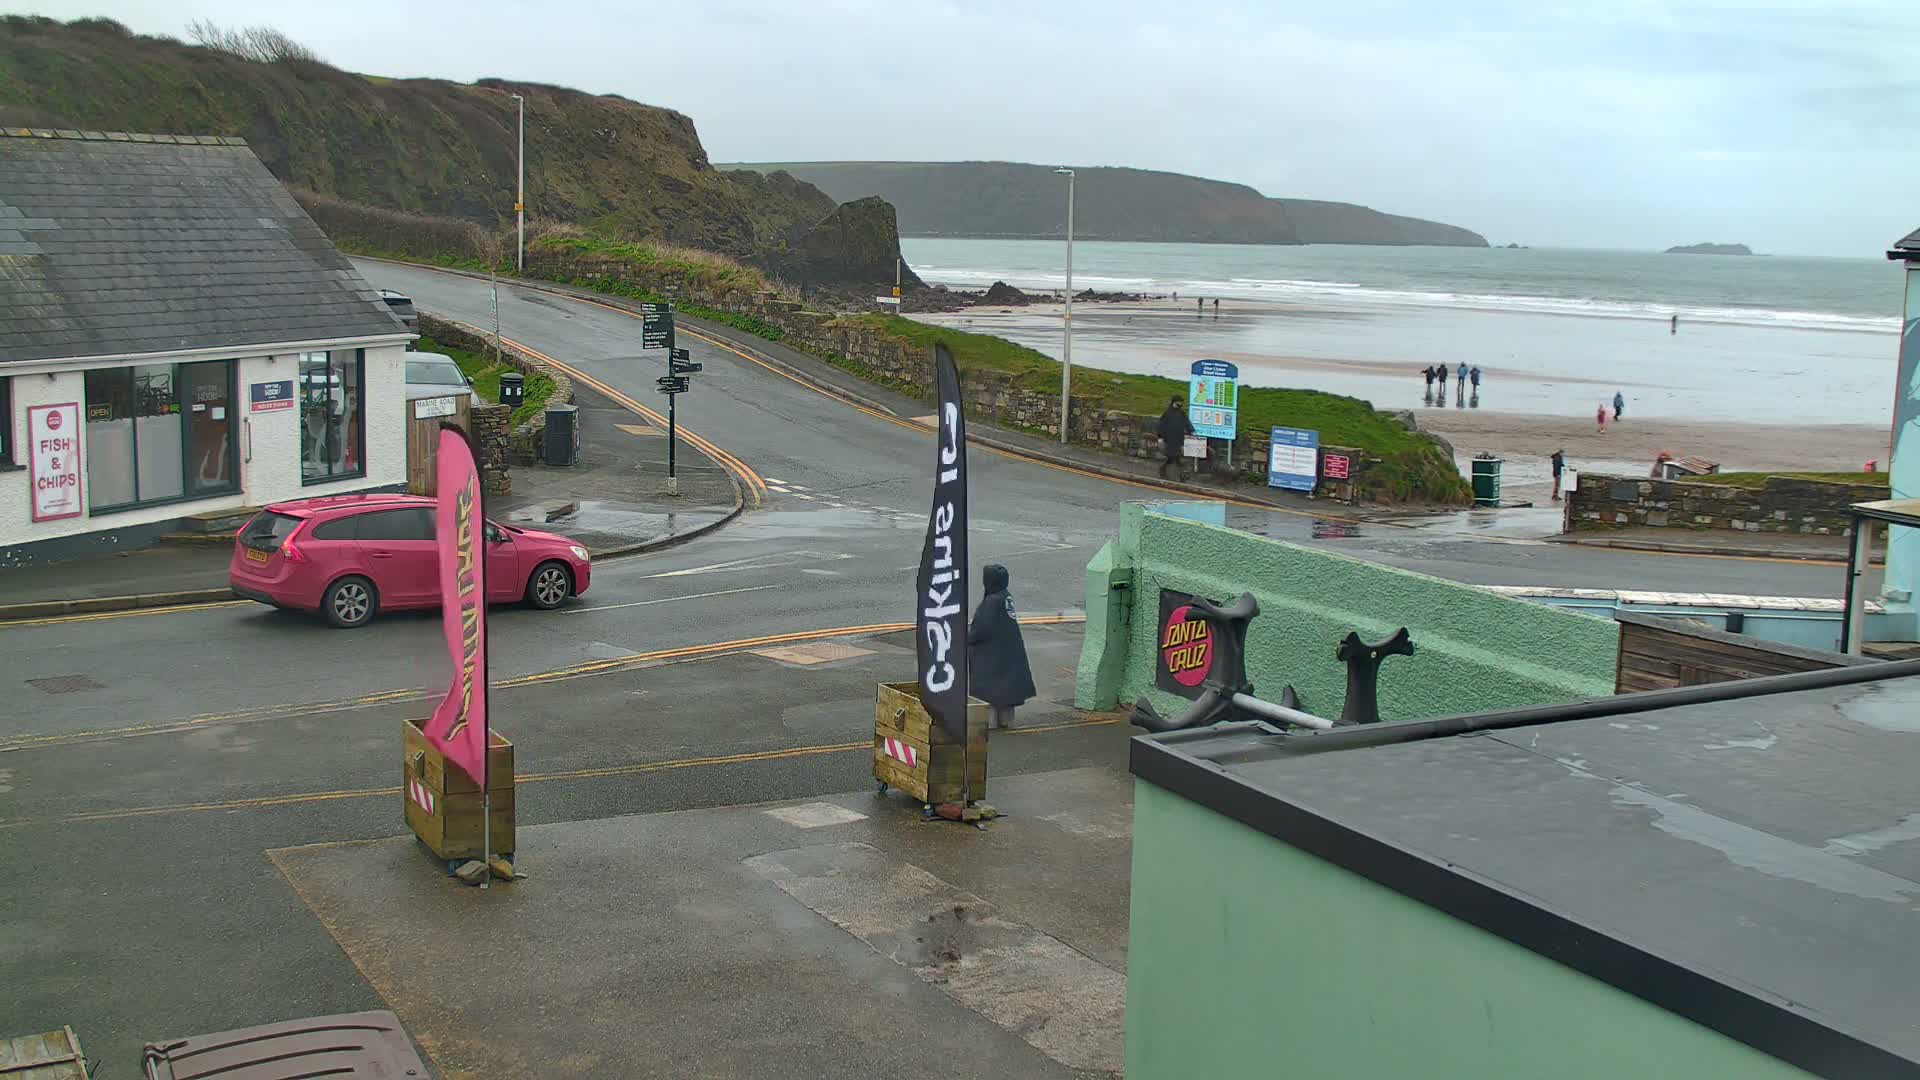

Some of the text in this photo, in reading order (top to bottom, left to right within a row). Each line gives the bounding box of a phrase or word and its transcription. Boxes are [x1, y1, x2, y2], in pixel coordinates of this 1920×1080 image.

[416, 398, 455, 408] MARINE ROAD
[90, 408, 110, 417] OPEN
[40, 438, 70, 454] FISH
[51, 457, 61, 470] &
[38, 473, 76, 490] CHIPS
[1162, 620, 1208, 649] SANTA
[1169, 643, 1207, 673] CRUZ
